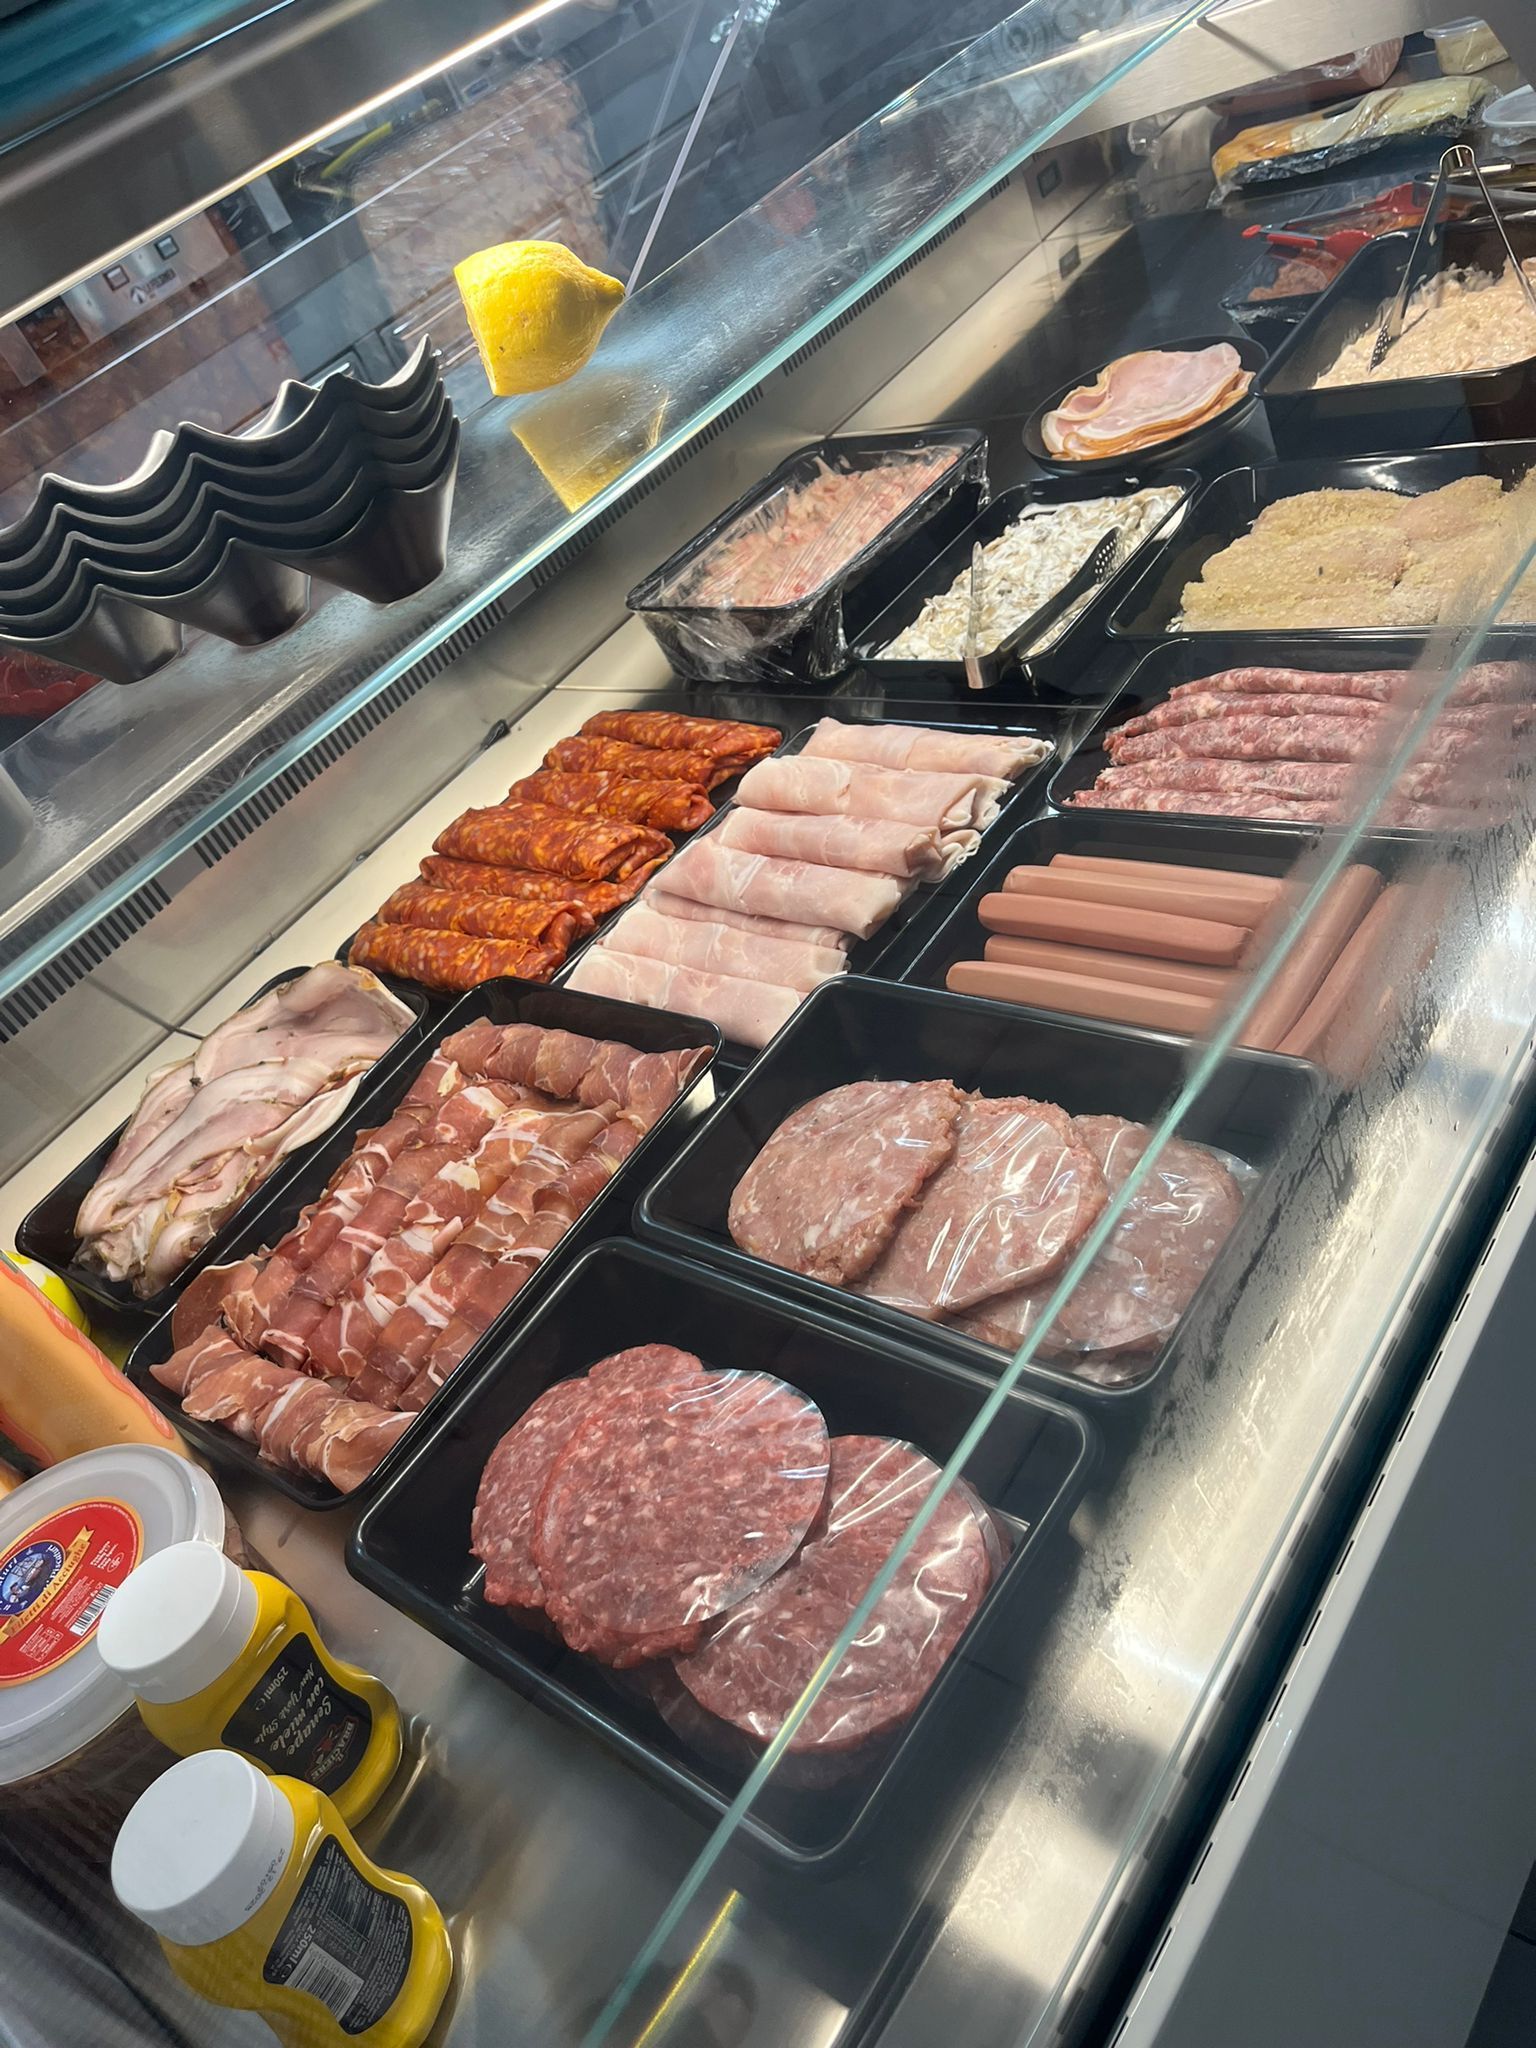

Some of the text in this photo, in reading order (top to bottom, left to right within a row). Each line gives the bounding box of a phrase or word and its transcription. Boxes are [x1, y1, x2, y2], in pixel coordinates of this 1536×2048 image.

[11, 1602, 41, 1633] Filetti
[41, 1591, 52, 1609] di
[53, 1541, 87, 1592] Acciughe
[264, 1666, 289, 1701] 250ml
[278, 1690, 301, 1719] York
[254, 1718, 279, 1744] Style
[270, 1676, 325, 1751] con miele
[286, 1695, 332, 1756] Senape
[310, 1722, 355, 1781] BRACIERE
[291, 1924, 317, 1965] 250ml
